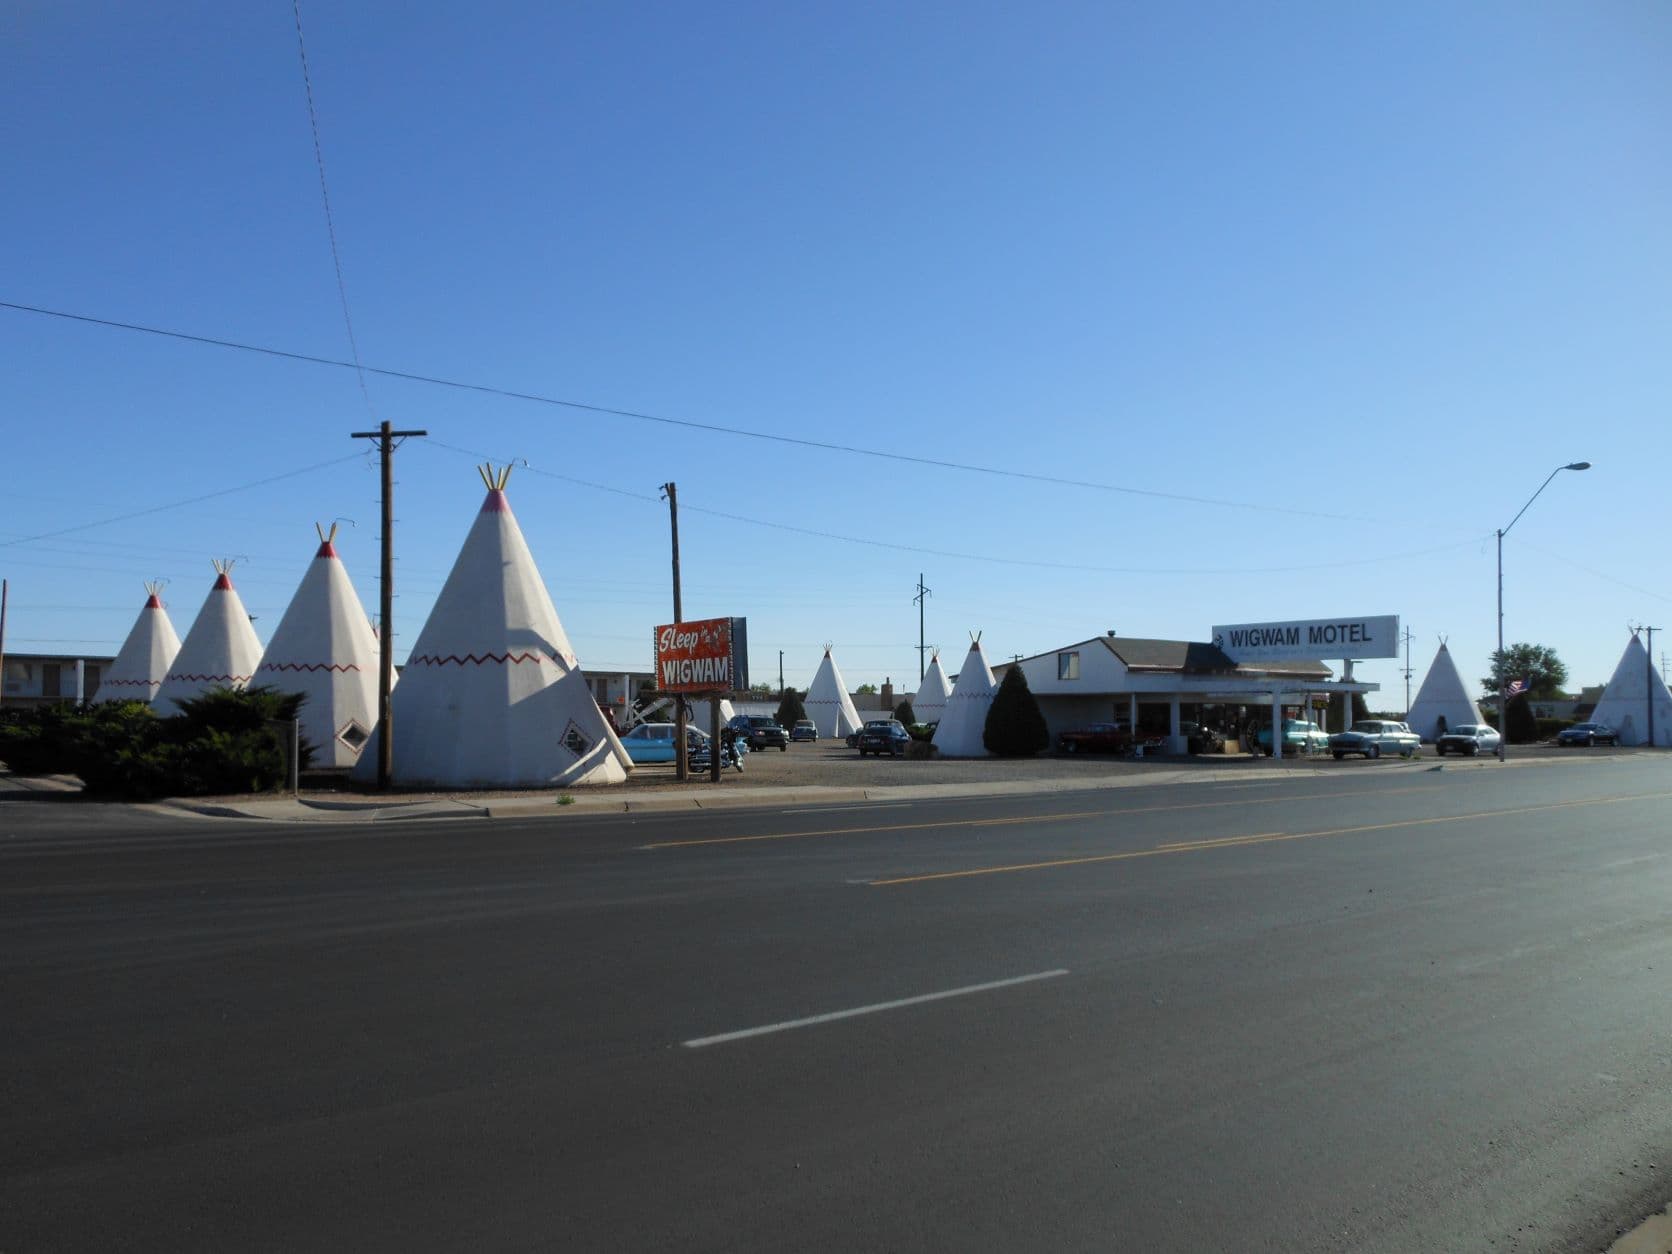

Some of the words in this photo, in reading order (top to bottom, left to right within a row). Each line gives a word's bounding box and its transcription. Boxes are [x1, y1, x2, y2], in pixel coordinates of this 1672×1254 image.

[659, 628, 698, 655] Sleep
[1230, 627, 1300, 648] WIGWAM
[1309, 623, 1372, 644] MOTEL
[662, 657, 728, 685] WIGWAM
